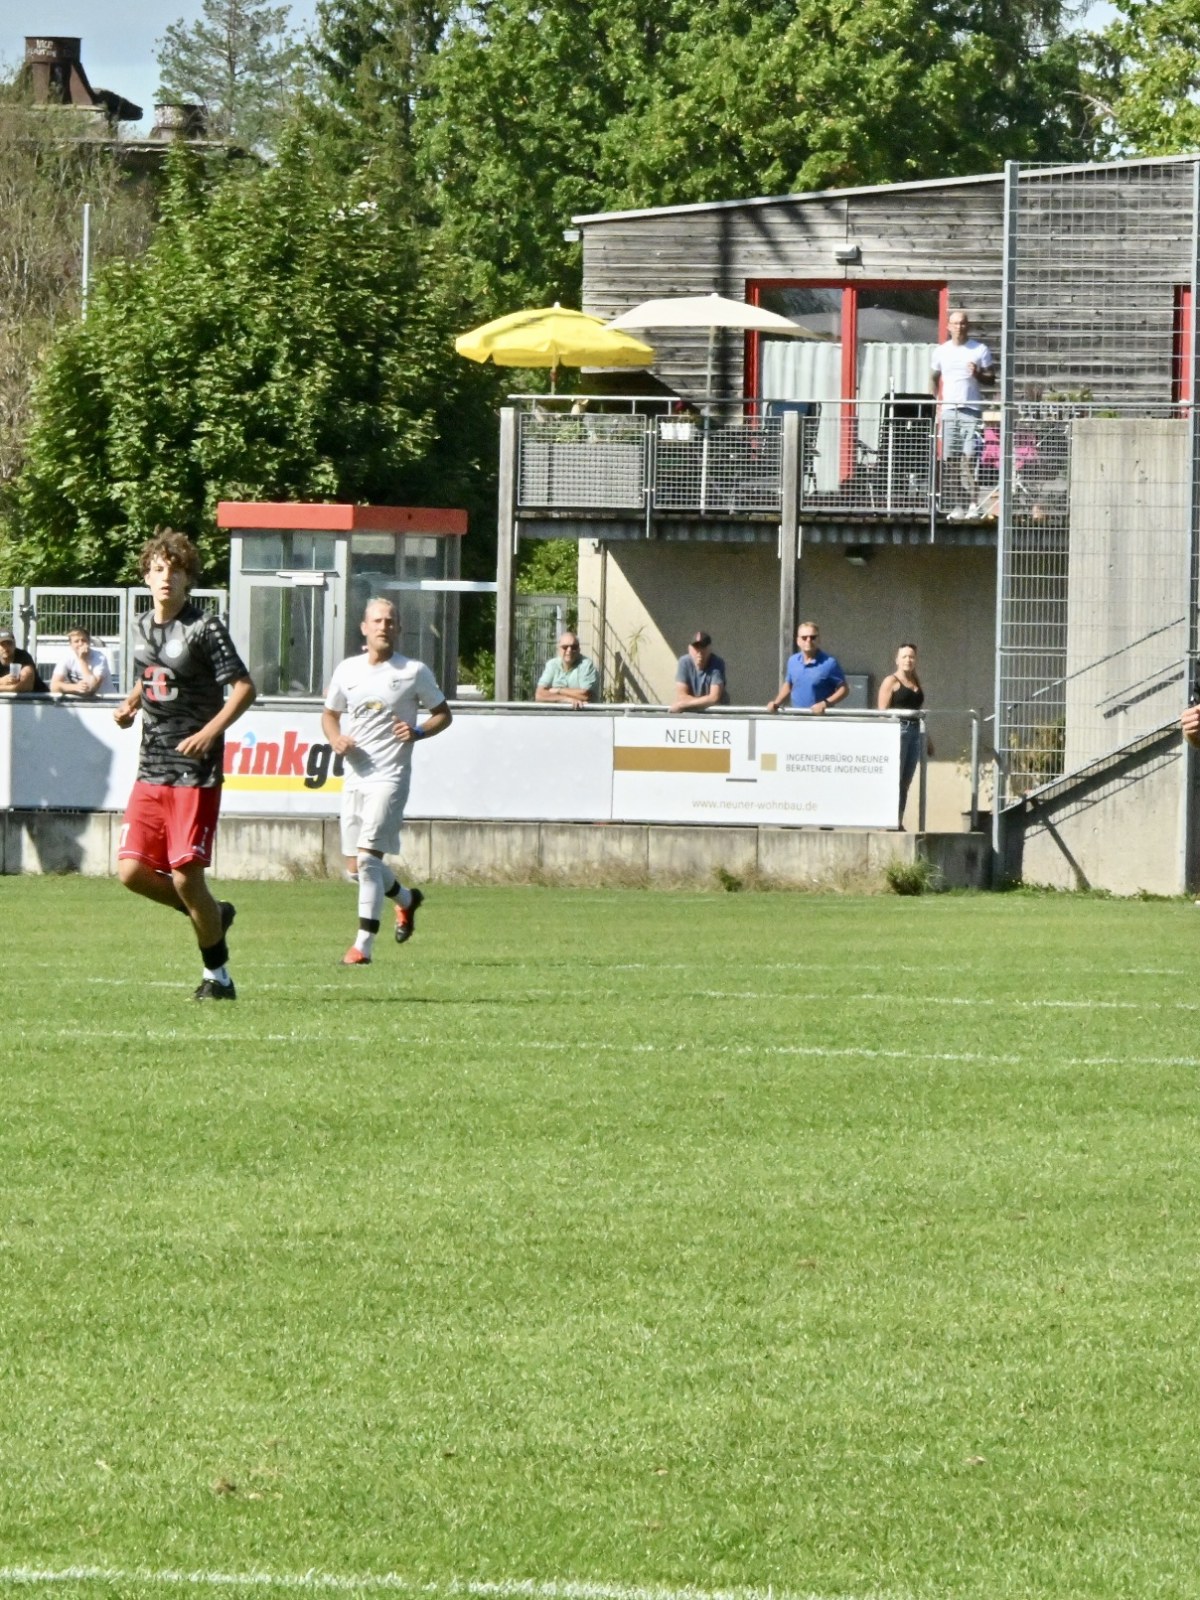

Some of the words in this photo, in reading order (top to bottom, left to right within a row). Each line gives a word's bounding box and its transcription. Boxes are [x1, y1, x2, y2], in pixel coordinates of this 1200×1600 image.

[665, 729, 732, 745] NEUNER
[786, 752, 853, 764] INGENIEURBÜRO
[855, 755, 889, 764] NEUNER
[785, 763, 833, 774] BERATENDE
[834, 765, 884, 775] INGENIEURE
[691, 799, 818, 812] www.neuner-wohnbau.de
